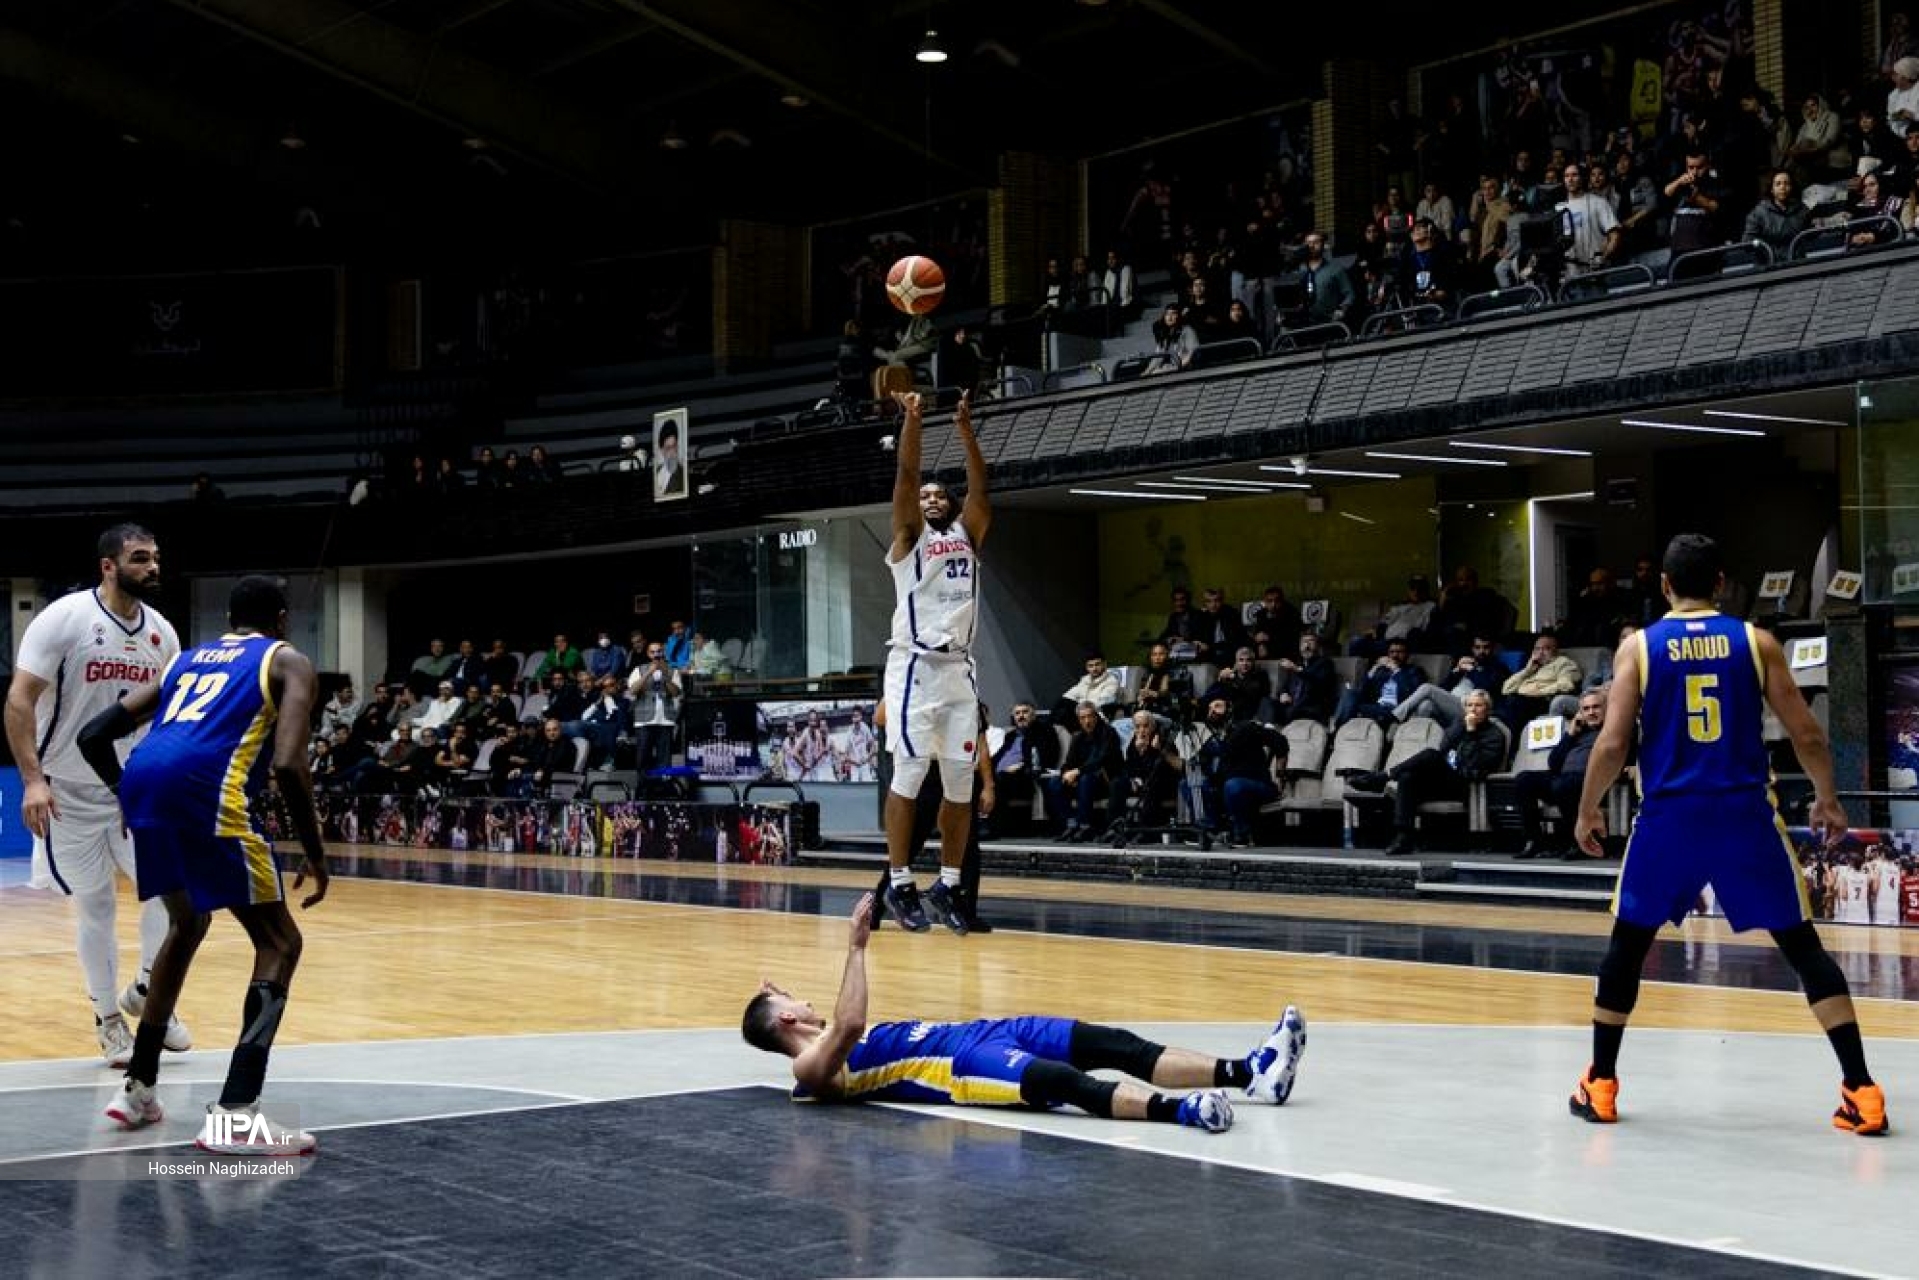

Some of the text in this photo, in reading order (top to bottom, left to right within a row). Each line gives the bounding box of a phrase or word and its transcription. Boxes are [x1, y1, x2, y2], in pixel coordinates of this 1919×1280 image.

[779, 529, 817, 550] RADIO
[944, 558, 970, 579] 32
[192, 647, 246, 664] KEMP
[1667, 635, 1730, 661] SAOUD
[161, 672, 230, 725] 12
[1685, 674, 1723, 744] 5
